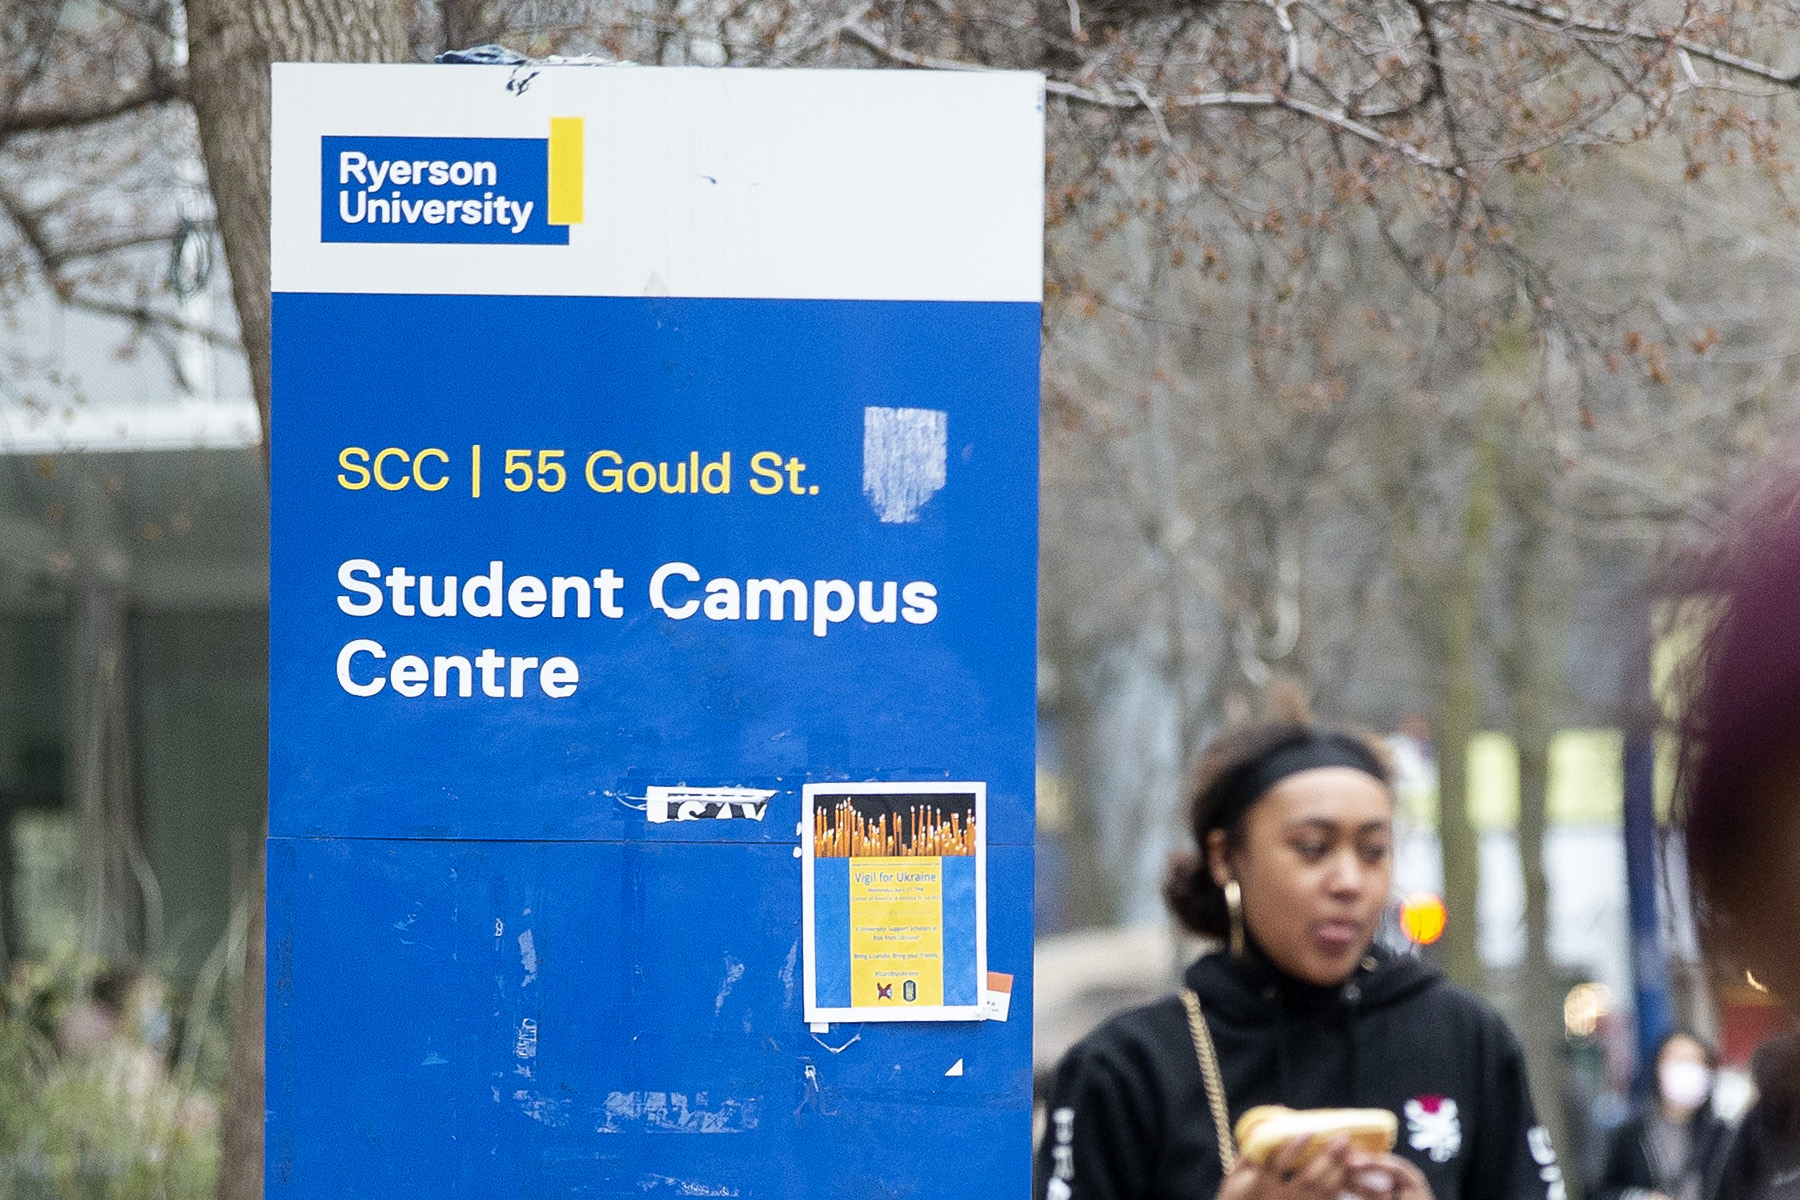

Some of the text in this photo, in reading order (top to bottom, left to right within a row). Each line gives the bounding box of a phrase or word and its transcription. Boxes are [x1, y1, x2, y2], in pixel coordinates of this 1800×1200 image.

[340, 151, 497, 192] Ryerson
[340, 190, 534, 234] University
[337, 446, 450, 492] SCC
[504, 449, 567, 493] 55
[585, 449, 731, 495] Gould
[749, 451, 820, 496] St.
[336, 558, 938, 638] Student Campus
[336, 639, 580, 699] Centre
[855, 871, 937, 886] Vigil for Ukraine
